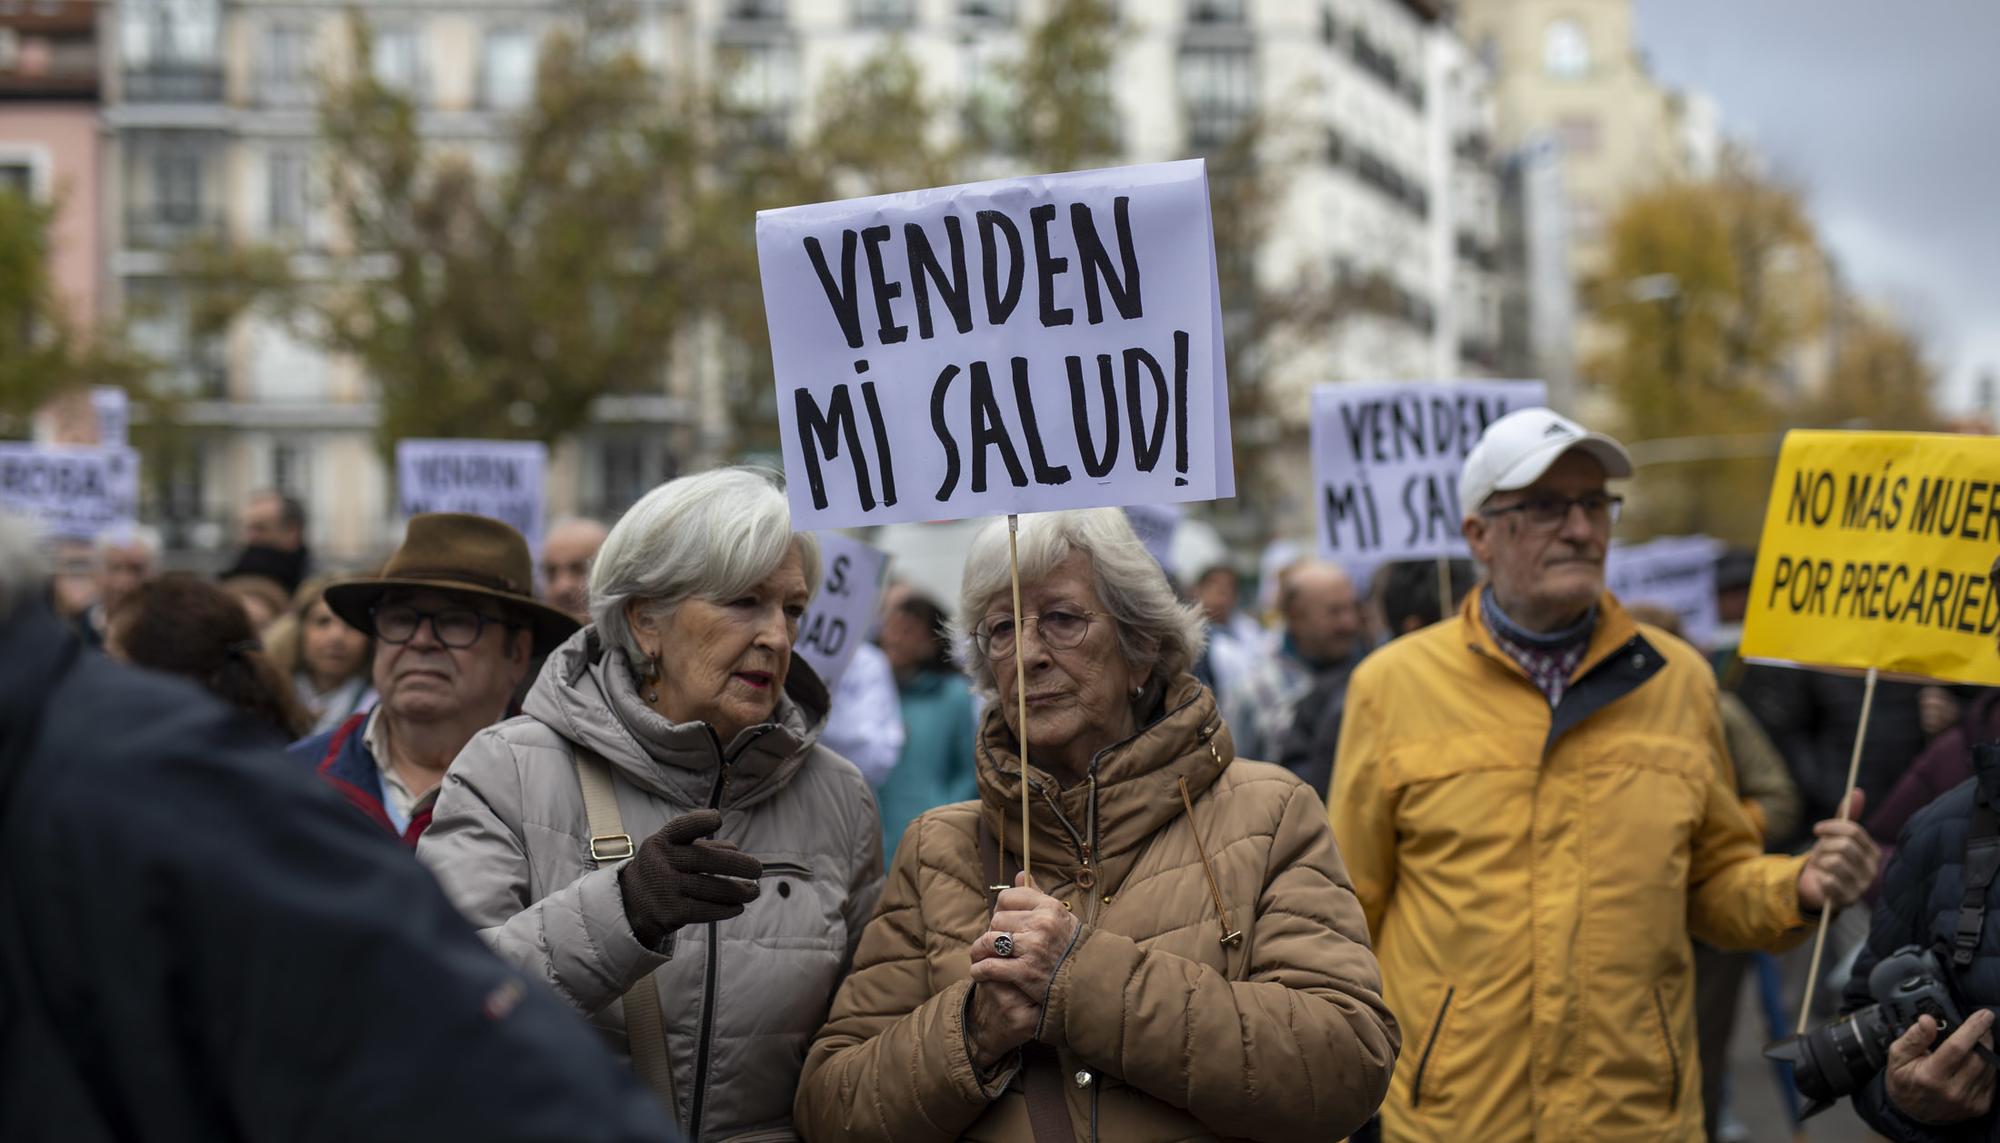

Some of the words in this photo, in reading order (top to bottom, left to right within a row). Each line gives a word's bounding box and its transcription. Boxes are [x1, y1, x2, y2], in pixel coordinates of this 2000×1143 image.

[804, 196, 1143, 348] VENDEN
[930, 330, 1189, 501] SALUD!
[1786, 470, 1836, 528] NO
[1840, 459, 1908, 531] MÁS
[1768, 556, 1834, 616] POR
